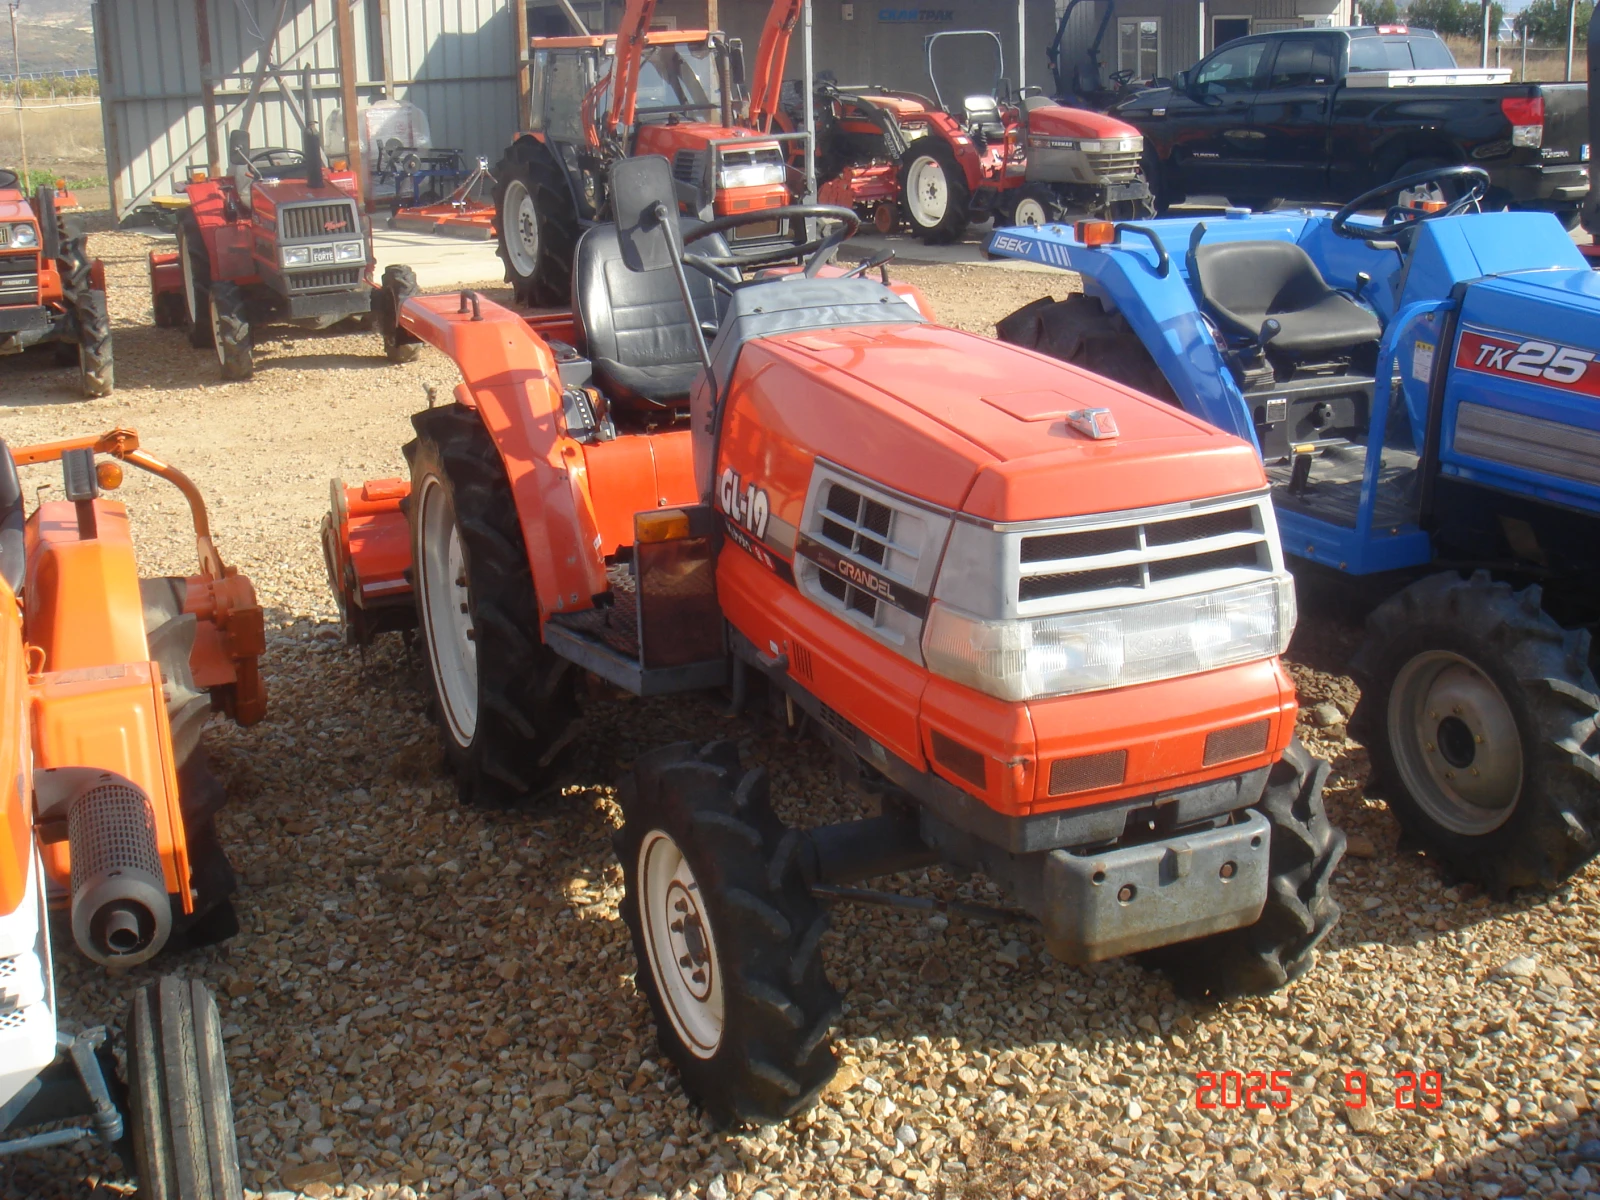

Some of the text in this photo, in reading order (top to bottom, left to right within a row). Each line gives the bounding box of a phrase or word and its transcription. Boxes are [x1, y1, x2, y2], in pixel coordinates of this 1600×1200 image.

[1541, 150, 1570, 159] TUNDRA
[994, 235, 1033, 255] ISEKI
[313, 251, 334, 262] FORTE
[1475, 341, 1596, 384] TK25
[838, 559, 896, 602] GRANDEL
